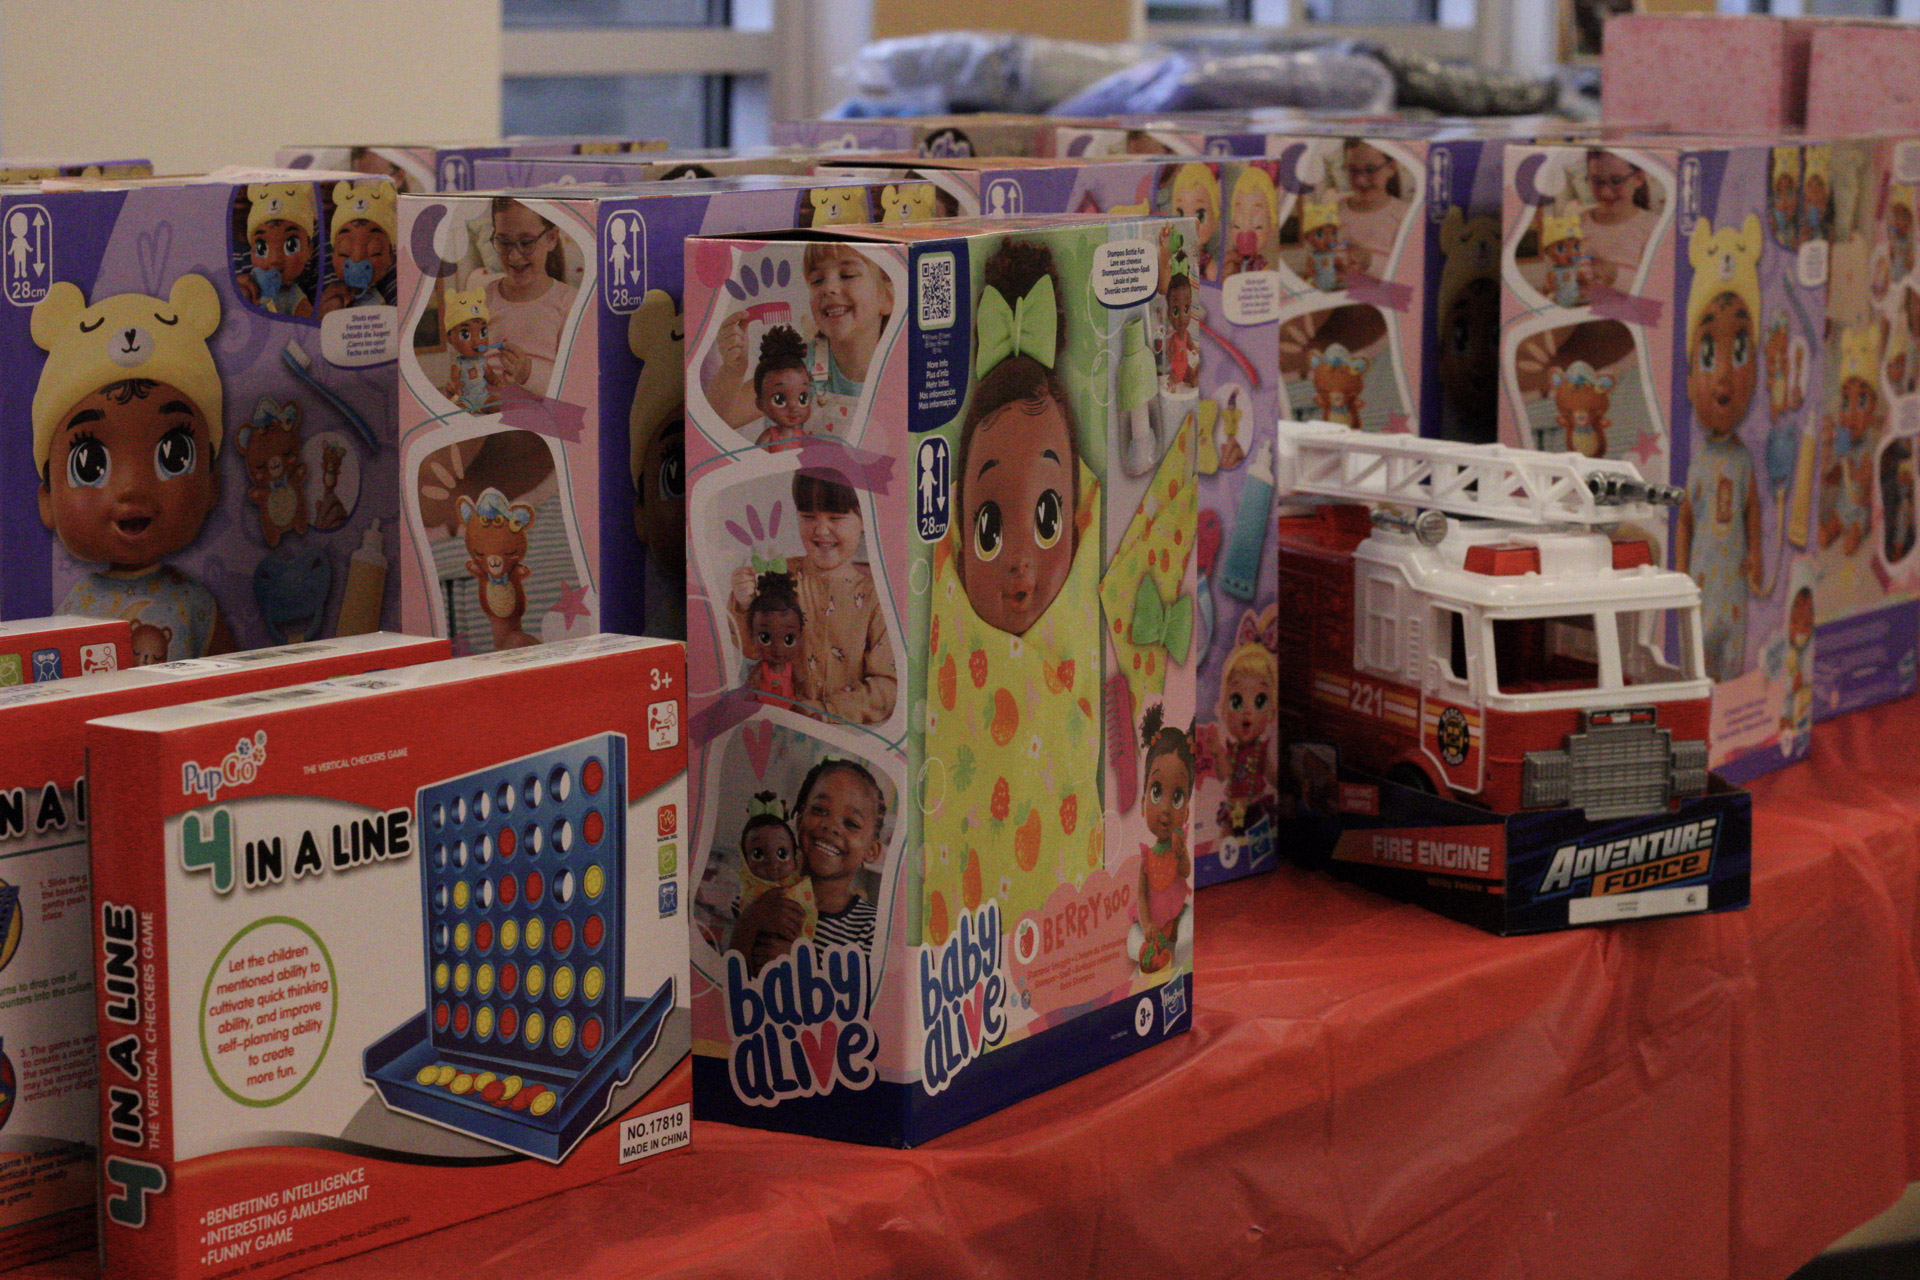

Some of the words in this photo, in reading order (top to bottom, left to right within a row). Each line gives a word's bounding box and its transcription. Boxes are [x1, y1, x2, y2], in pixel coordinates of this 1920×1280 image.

[12, 281, 46, 299] 28cm
[612, 288, 642, 307] 28cm
[921, 516, 946, 536] 28cm
[650, 668, 673, 691] 3+
[1350, 682, 1383, 718] 221
[182, 752, 257, 800] PupGo
[303, 764, 317, 775] THE
[318, 759, 350, 773] VERTICAL
[351, 752, 386, 767] CHECKERS
[388, 748, 408, 760] GAME
[36, 784, 67, 830] A
[181, 807, 234, 892] 4
[244, 835, 283, 886] IN
[294, 829, 323, 876] A
[332, 809, 411, 867] LINE
[1373, 834, 1414, 863] FIRE
[1417, 839, 1490, 873] ENGINE
[1539, 817, 1717, 893] ADVENTURE
[1602, 855, 1700, 893] FORCE
[140, 911, 154, 959] GAME
[1043, 892, 1102, 955] BERRY
[1104, 884, 1130, 921] BOO
[103, 902, 139, 1024] LINE
[228, 959, 244, 973] Let
[248, 954, 265, 968] the
[267, 946, 309, 964] children
[920, 905, 996, 1031] baby
[30, 978, 49, 990] drop
[216, 971, 274, 996] mentioned
[276, 964, 308, 982] ability
[310, 962, 321, 974] to
[727, 944, 861, 1037] baby
[142, 961, 158, 1044] CHECKERS
[209, 998, 255, 1017] cultivate
[257, 988, 285, 1008] quick
[287, 980, 329, 998] thinking
[218, 1016, 254, 1034] ability,
[256, 1008, 277, 1026] and
[279, 1001, 322, 1020] improve
[292, 1018, 323, 1036] ability
[1140, 1007, 1152, 1028] 3+
[23, 1061, 32, 1069] to
[34, 1054, 60, 1066] create
[30, 1046, 46, 1056] The
[48, 1041, 71, 1053] game
[107, 1035, 141, 1080] A
[248, 1054, 260, 1067] to
[262, 1046, 295, 1064] create
[23, 1071, 38, 1080] the
[40, 1065, 62, 1075] same
[23, 1080, 41, 1091] may
[43, 1078, 54, 1086] be
[146, 1047, 159, 1118] VERTICAL
[246, 1070, 275, 1086] more
[276, 1066, 297, 1079] fun.
[24, 1086, 62, 1102] vertically
[110, 1086, 143, 1147] IN
[627, 1112, 683, 1141] NO.17819
[148, 1122, 161, 1150] THE
[623, 1142, 648, 1158] MADE
[650, 1140, 659, 1150] IN
[661, 1130, 688, 1147] CHINA
[106, 1155, 166, 1229] 4
[282, 1168, 365, 1204] INTELLIGENCE
[290, 1185, 370, 1222] AMUSEMENT
[254, 1226, 294, 1251] GAME
